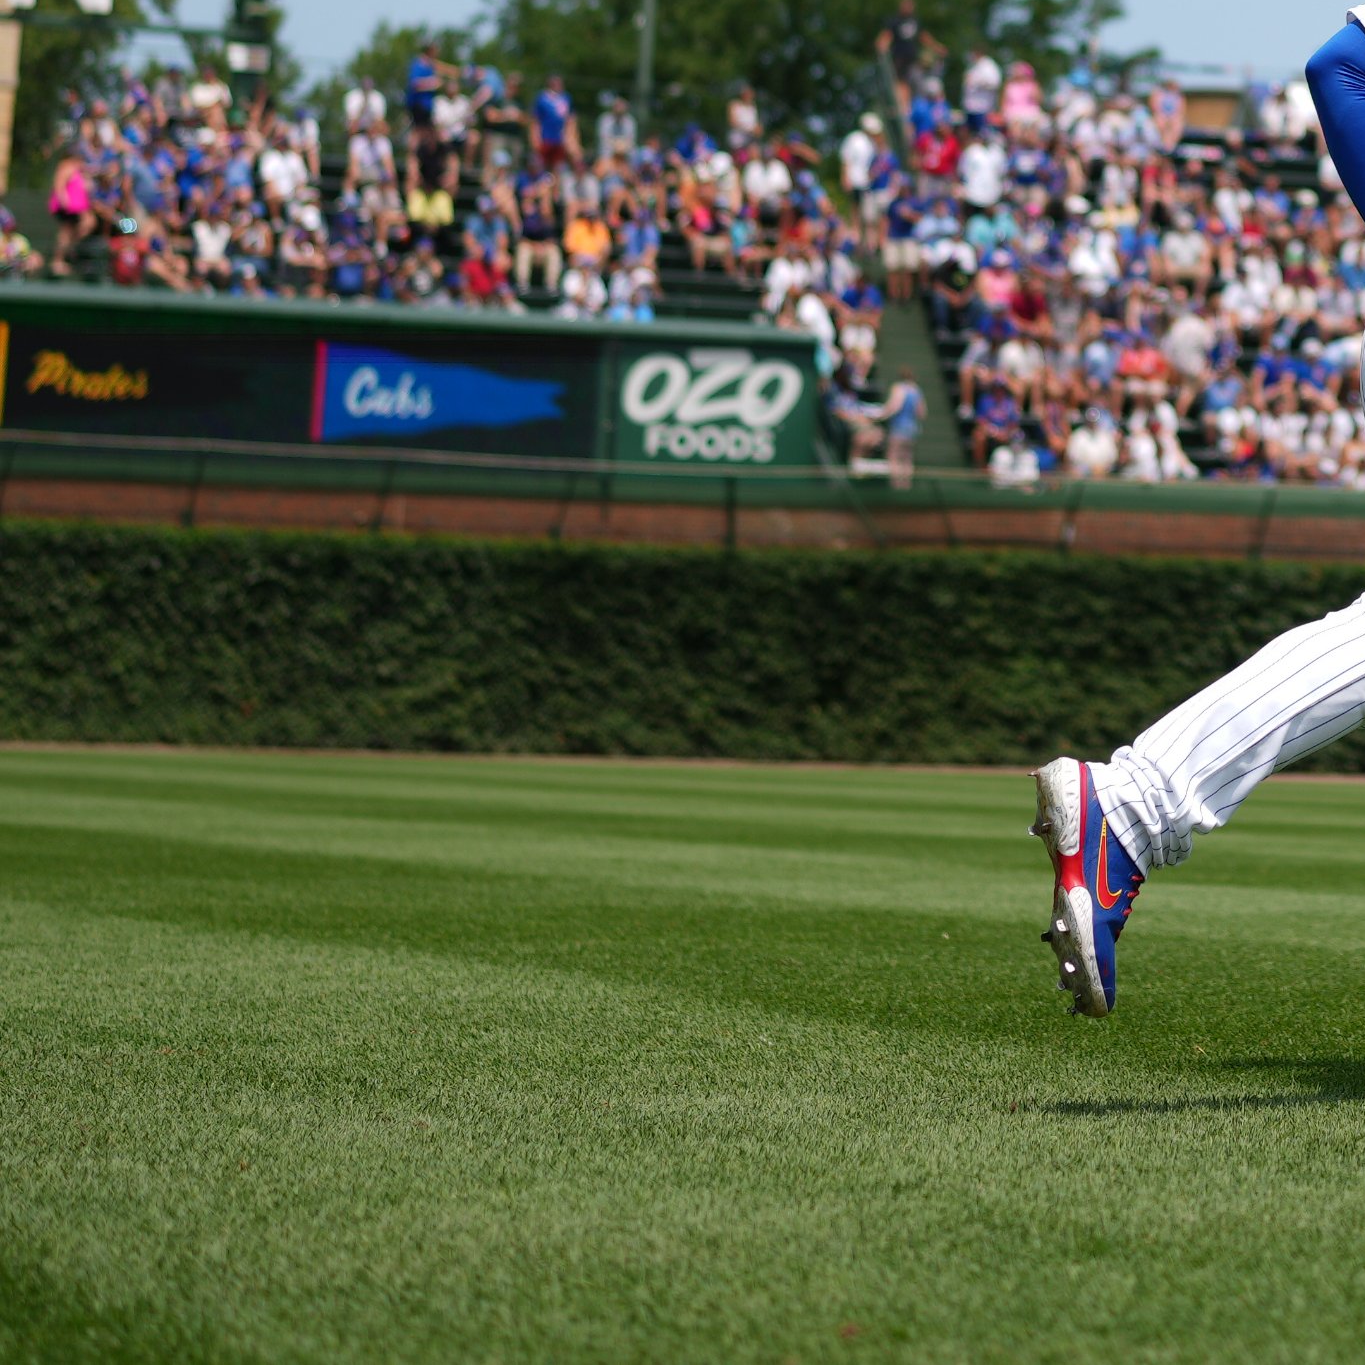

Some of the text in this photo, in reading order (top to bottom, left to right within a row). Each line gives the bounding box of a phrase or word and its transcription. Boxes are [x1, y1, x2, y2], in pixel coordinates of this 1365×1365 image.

[25, 350, 149, 401] Pirates
[343, 364, 434, 420] Cubs
[622, 347, 804, 429] OZO
[643, 423, 776, 463] FOODS
